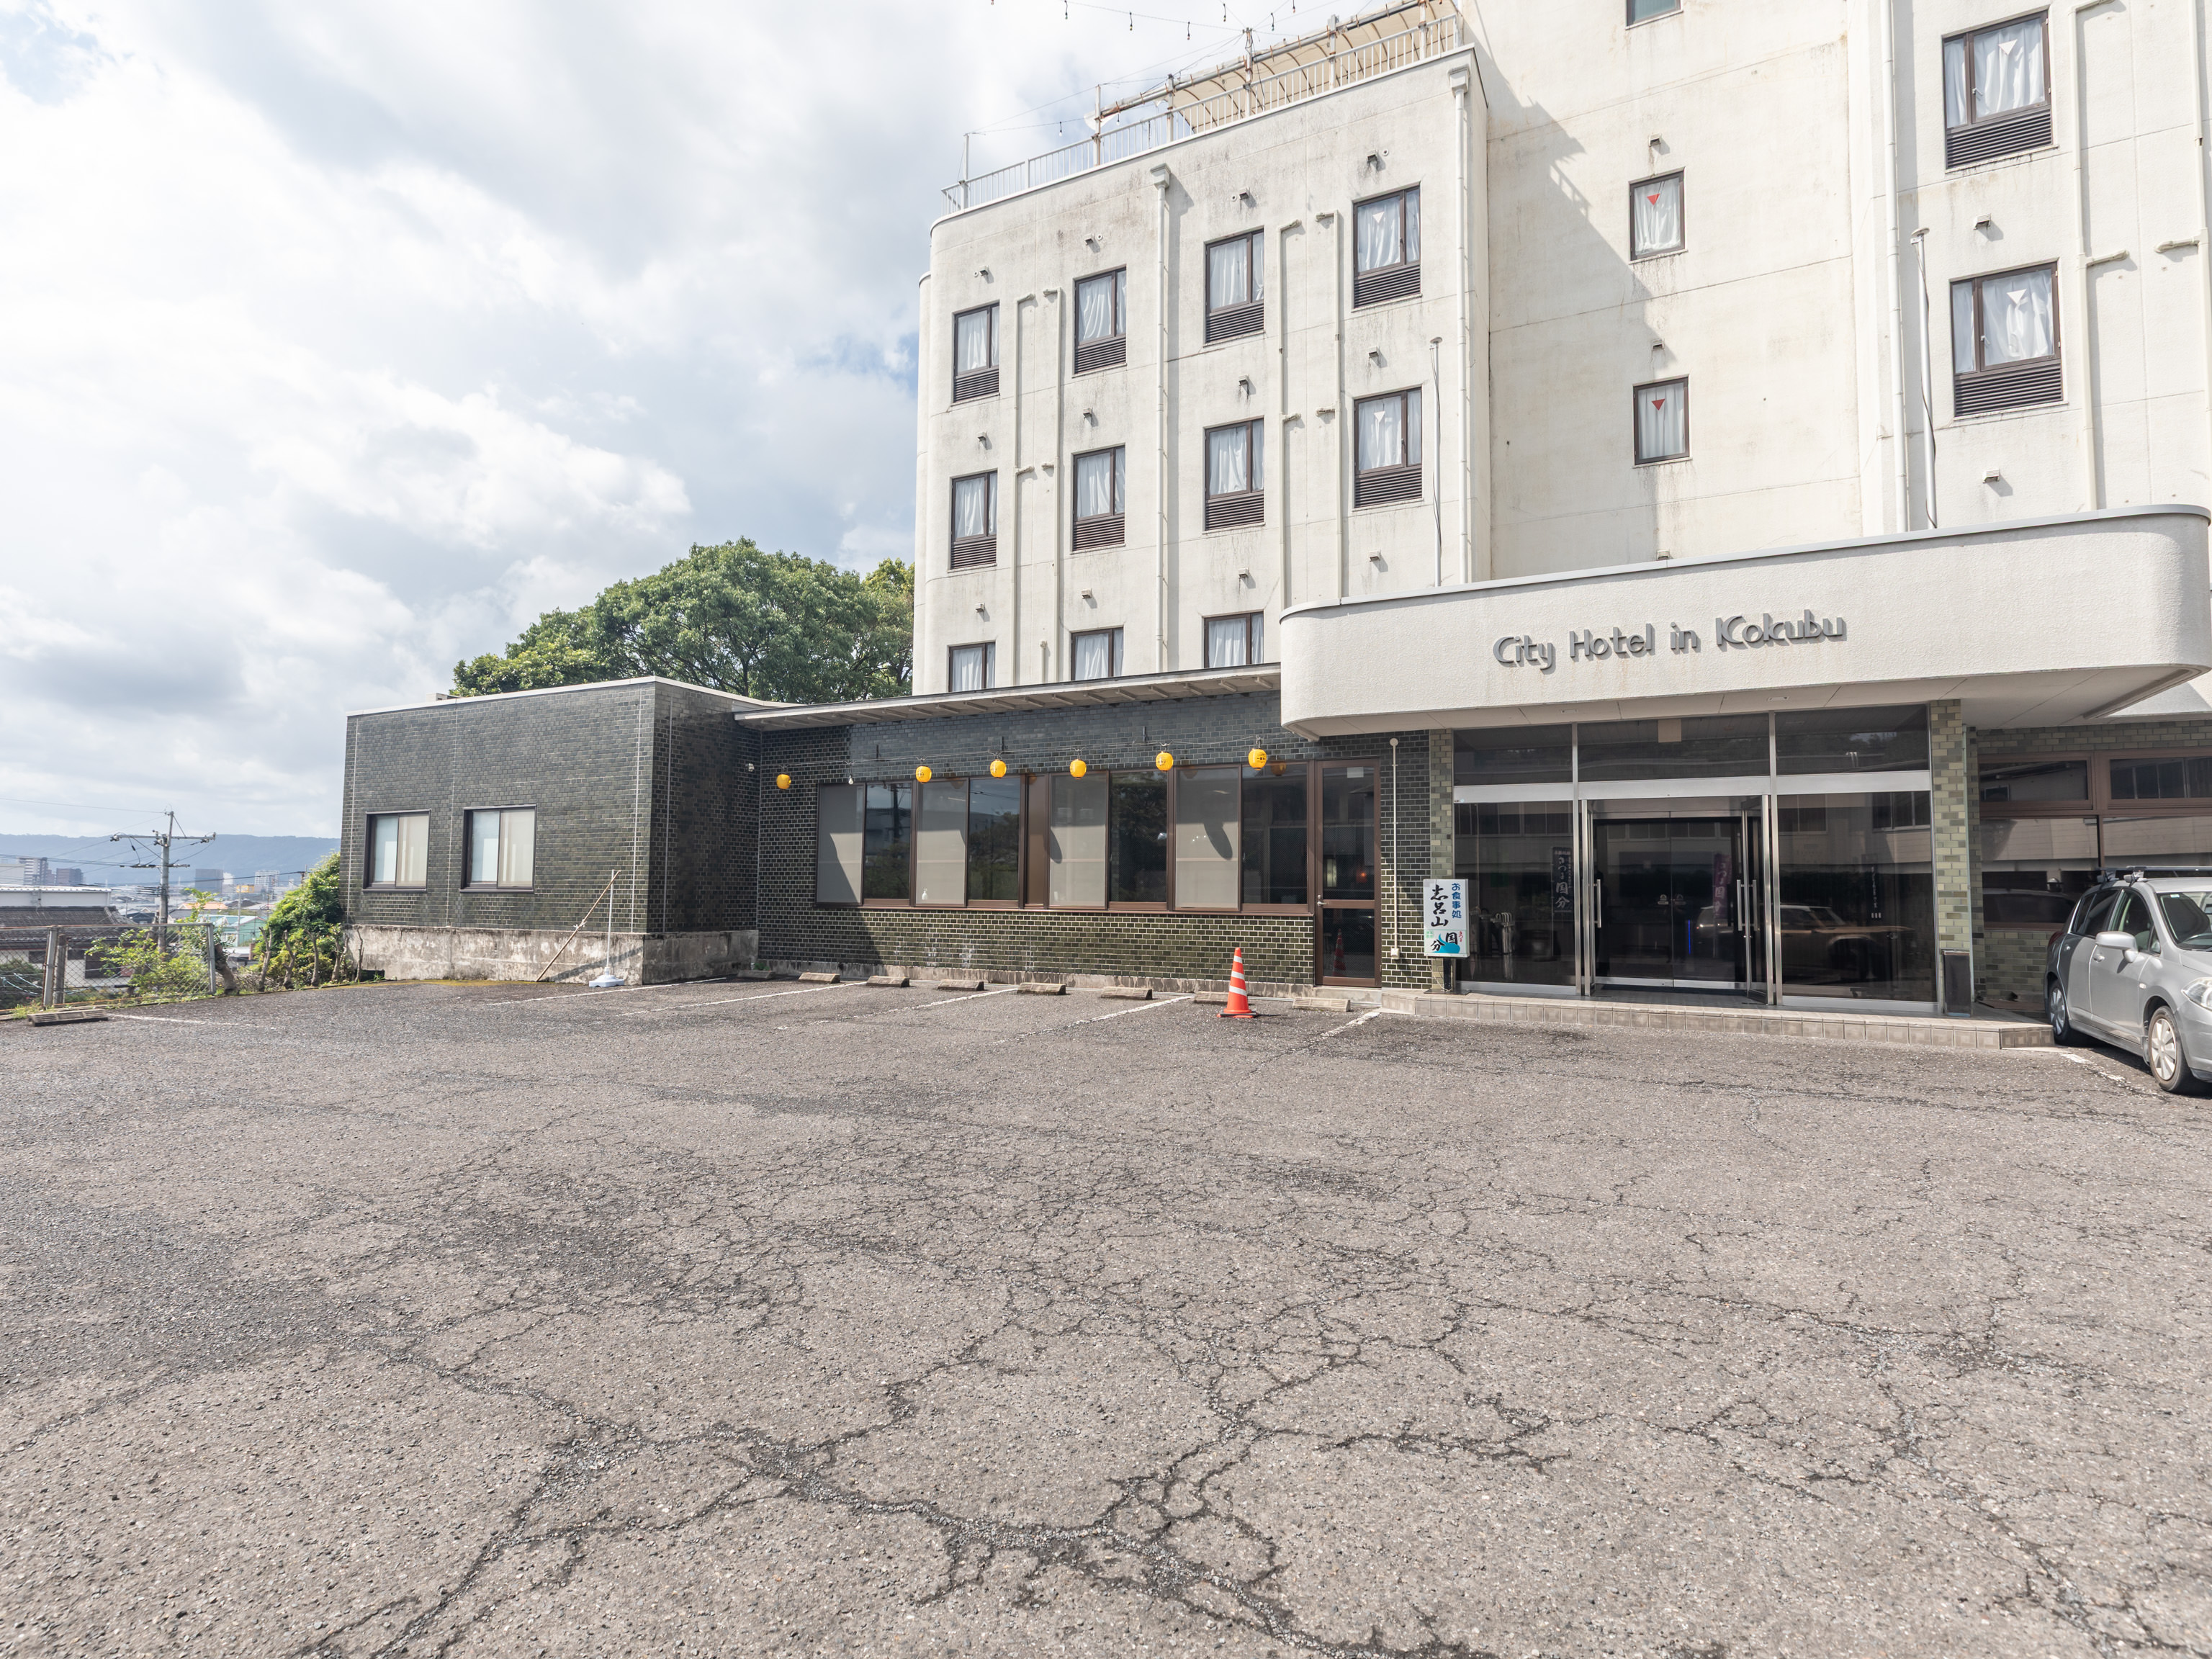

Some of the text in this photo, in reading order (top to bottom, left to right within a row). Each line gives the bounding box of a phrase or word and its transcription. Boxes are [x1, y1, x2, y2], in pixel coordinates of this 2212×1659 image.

[1493, 609, 1844, 670] City Hotel in Kokubu
[1452, 883, 1462, 919] お食事処
[1430, 932, 1458, 951] 国分
